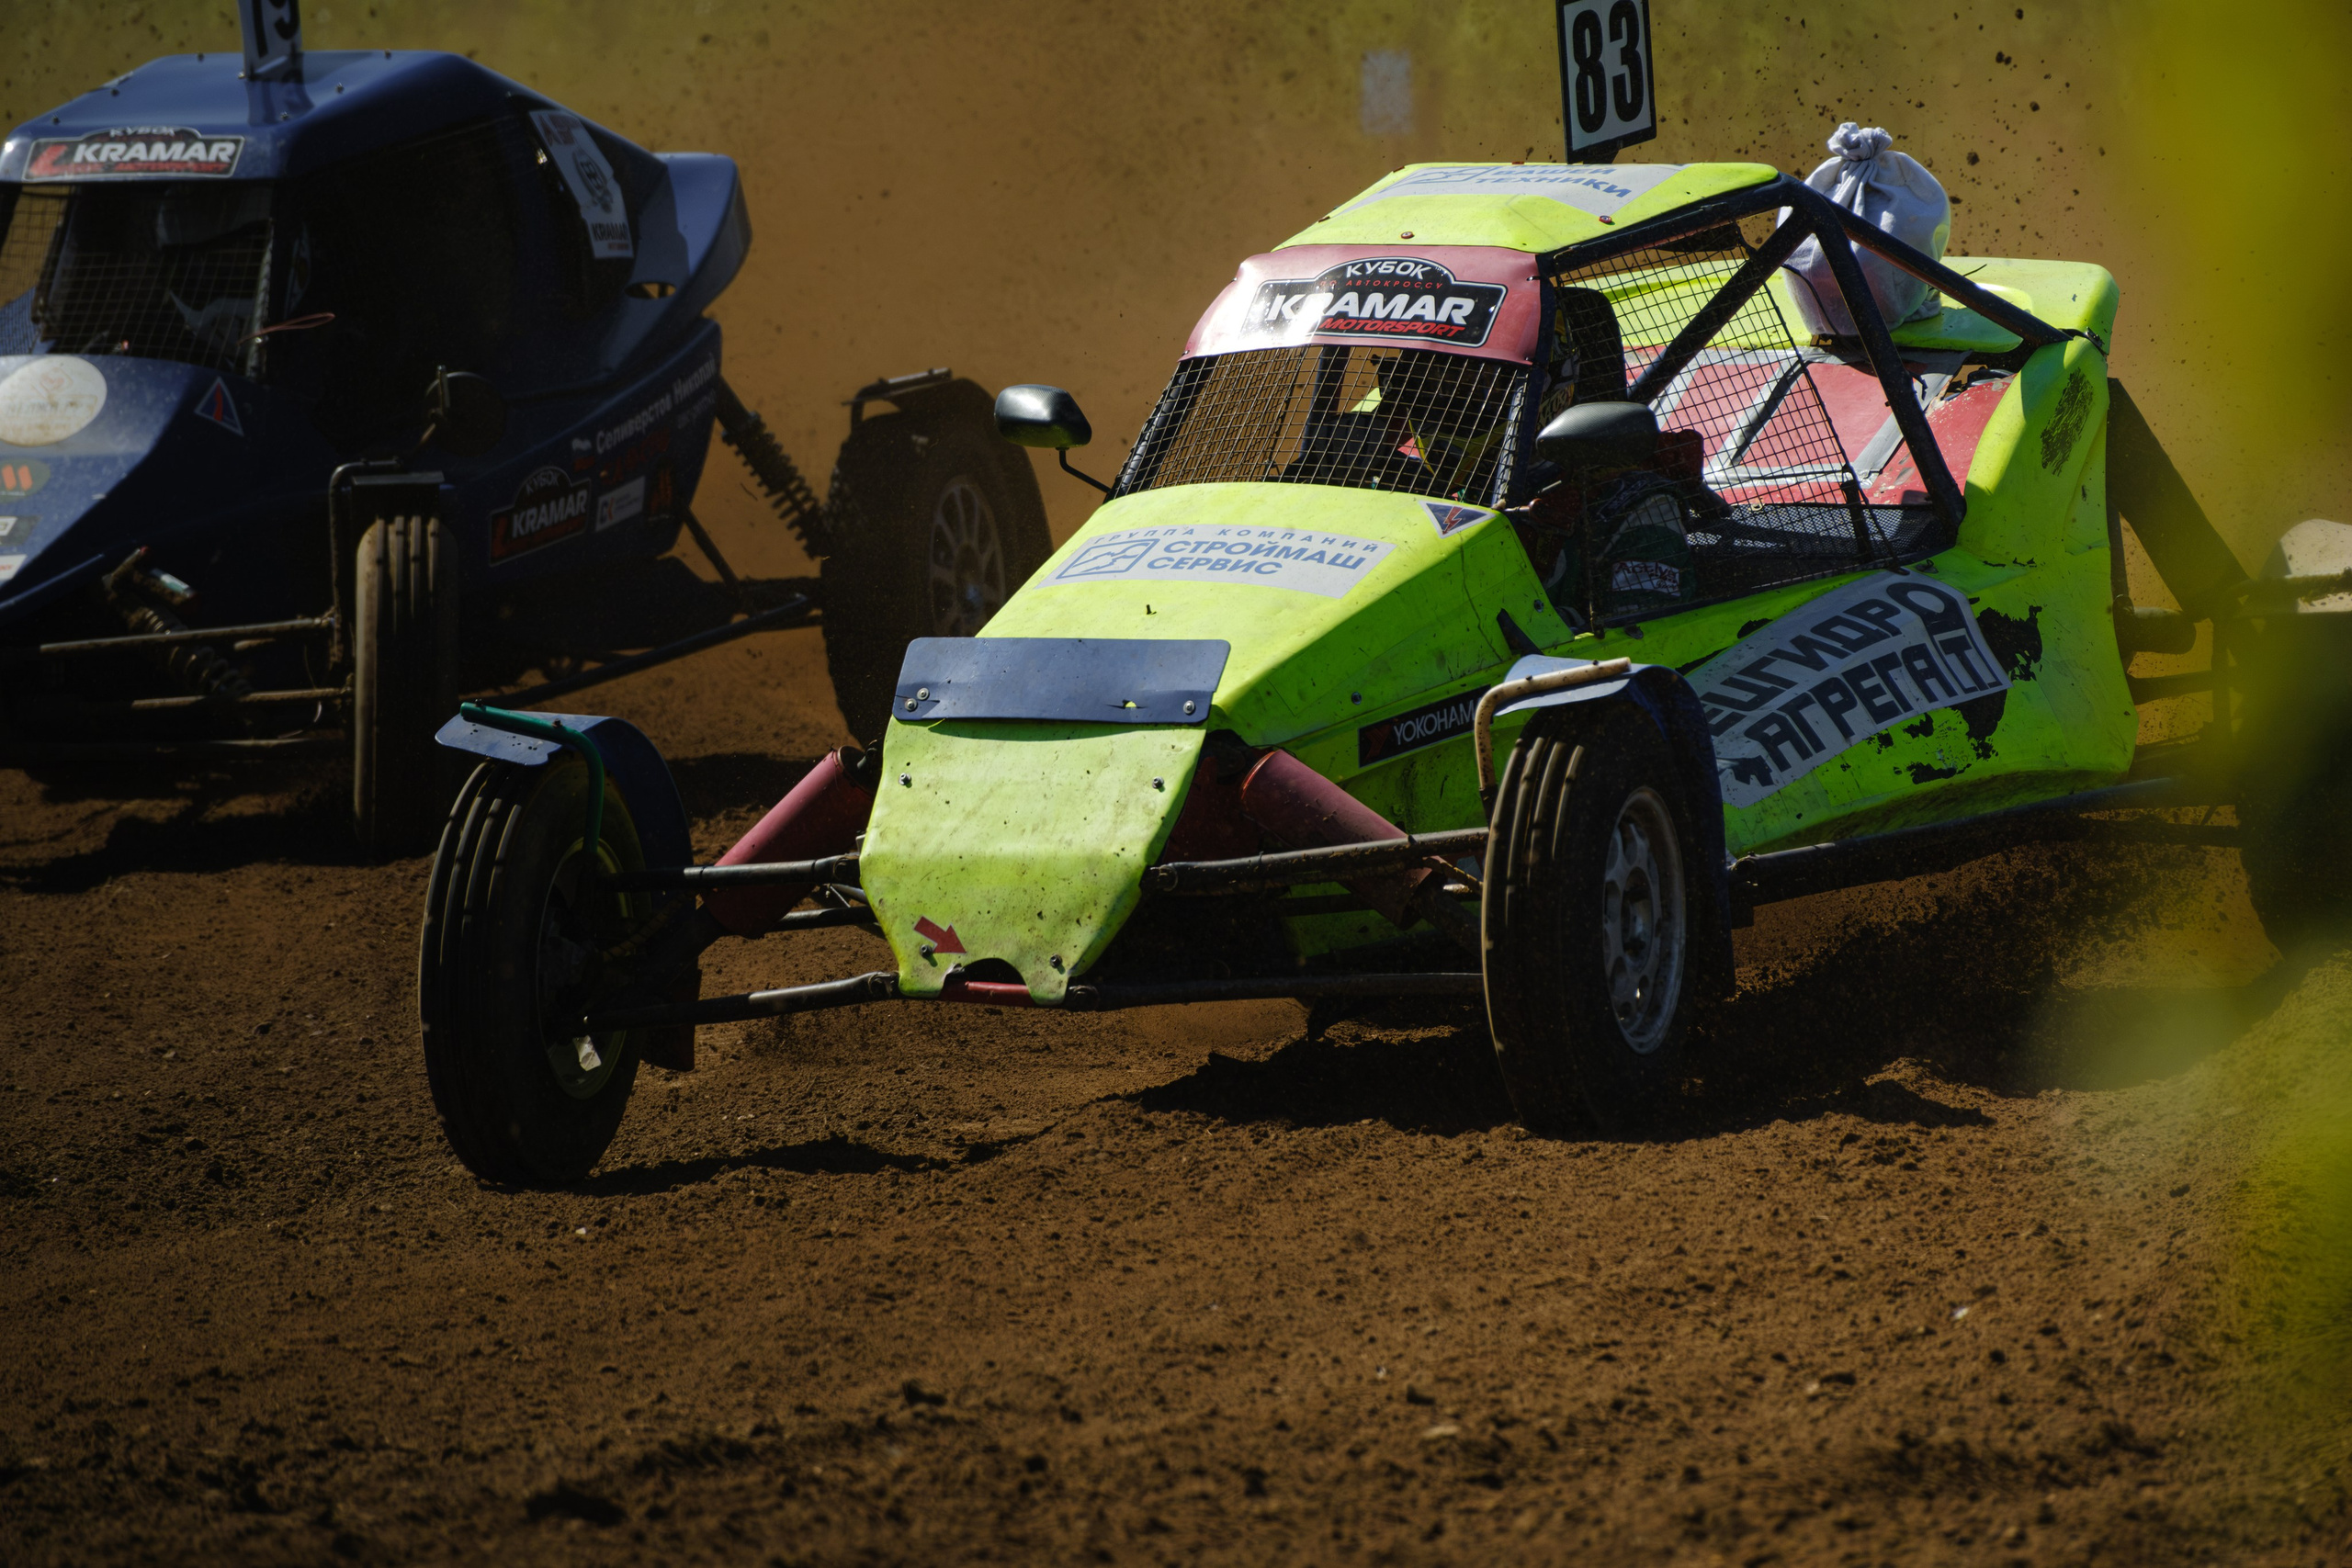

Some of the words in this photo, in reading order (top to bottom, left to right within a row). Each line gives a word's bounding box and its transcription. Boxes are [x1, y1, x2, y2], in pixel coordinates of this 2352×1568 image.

[1572, 0, 1644, 133] 83
[74, 141, 237, 164] KRAMAR
[1476, 176, 1632, 197] ТЕХНИКИ
[1346, 261, 1432, 279] КУБОК
[1346, 279, 1443, 289] АВТОКРОССУ
[1266, 291, 1476, 325] KRAMAR
[1318, 318, 1466, 338] MOTORSPORT
[511, 489, 588, 539] KRAMAR
[1094, 528, 1196, 545] ГРУППА
[1217, 528, 1378, 553] КОМПАНИЙ
[1147, 557, 1283, 576] СЕРВИС
[1163, 540, 1367, 570] СТРОЙМАШ
[1744, 635, 1990, 773] АГРЕГАТ
[1394, 698, 1476, 746] YOKOHAM
